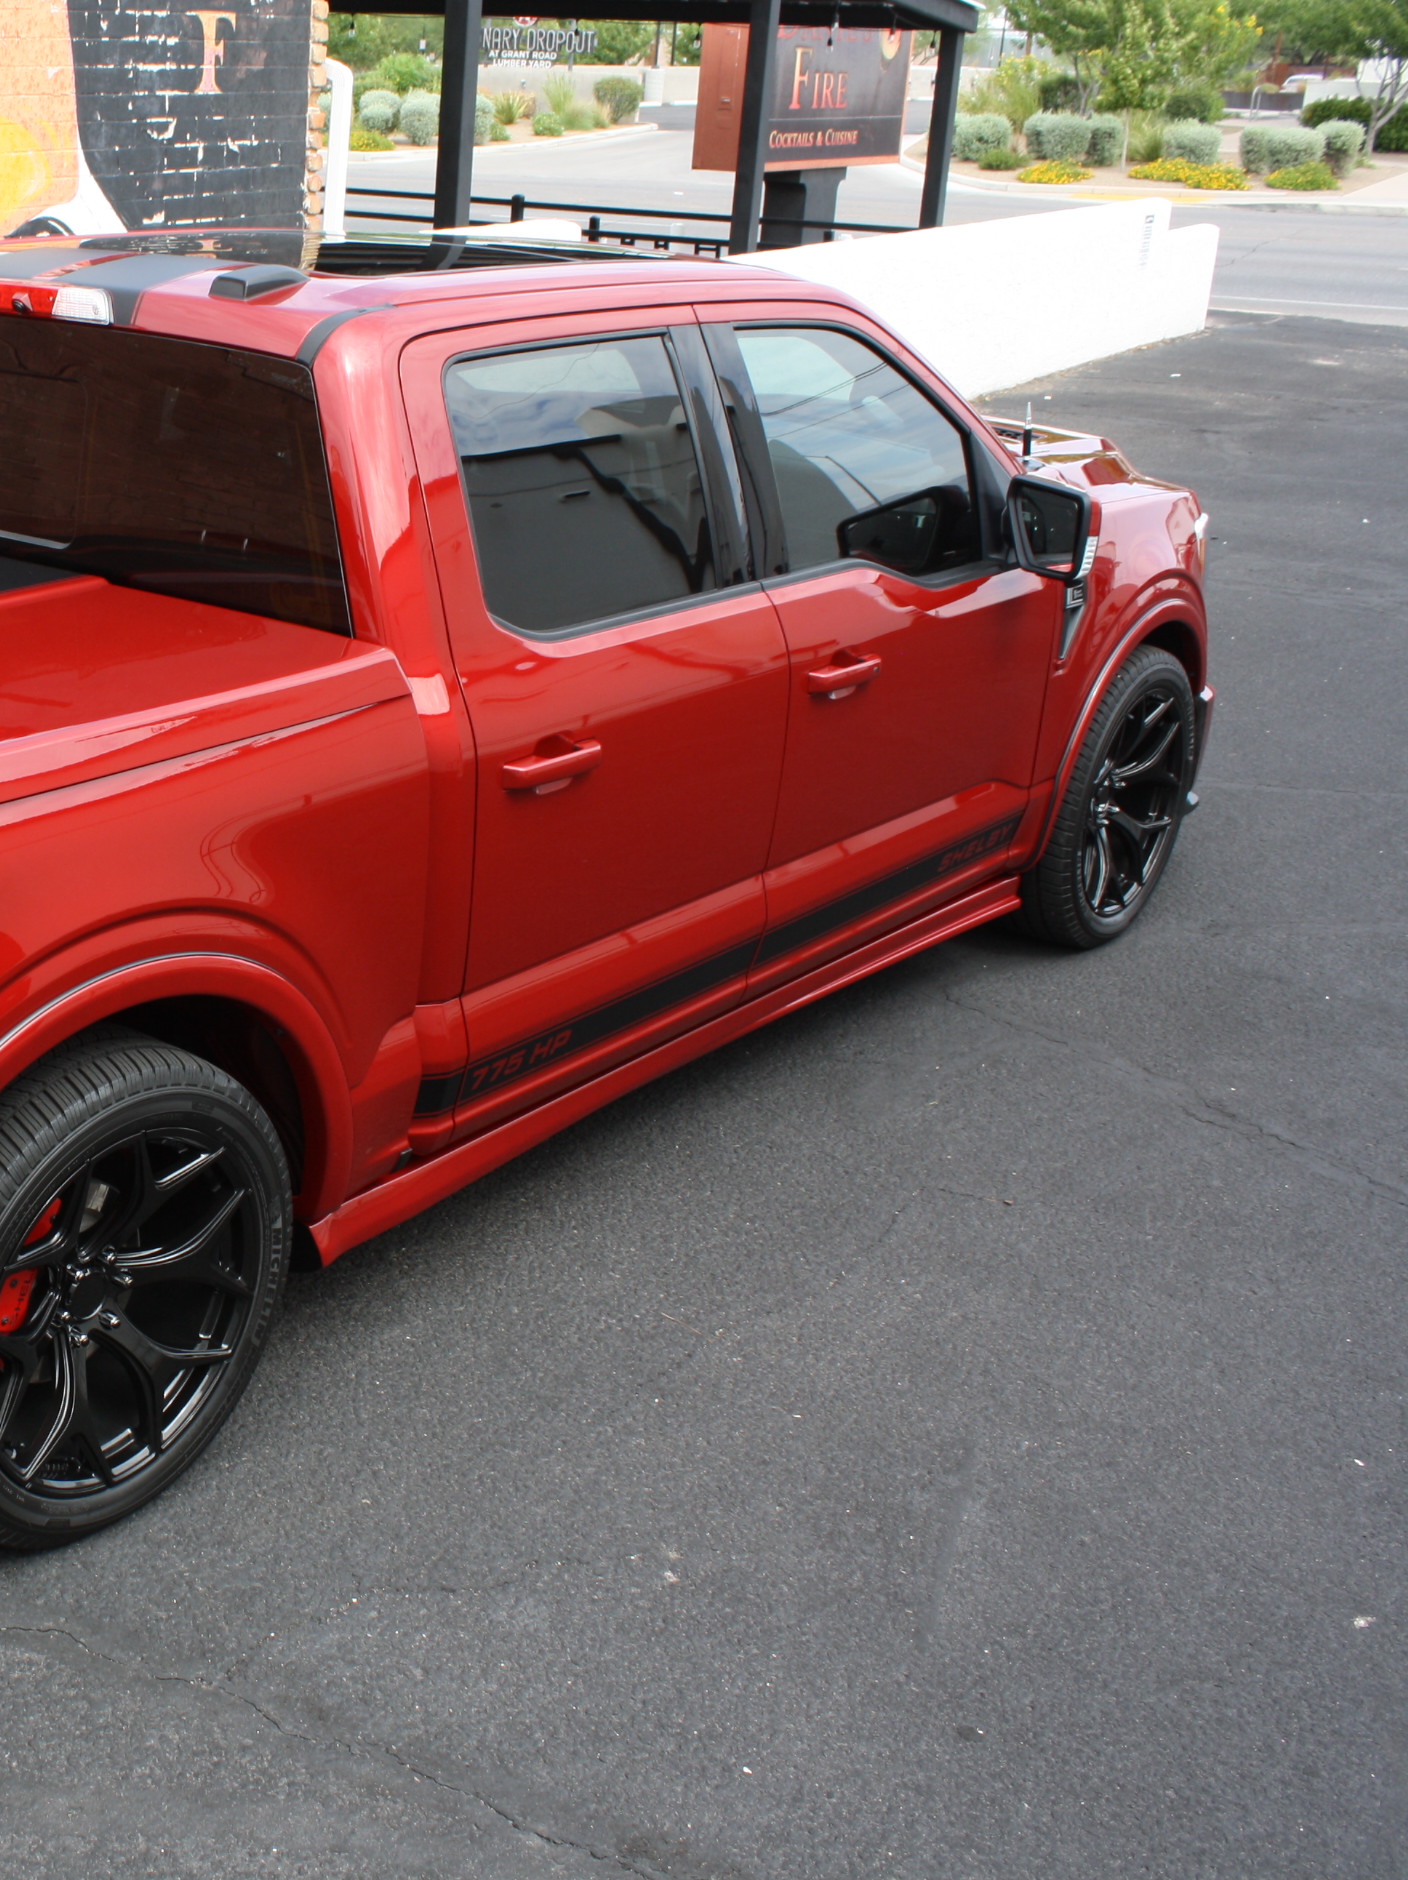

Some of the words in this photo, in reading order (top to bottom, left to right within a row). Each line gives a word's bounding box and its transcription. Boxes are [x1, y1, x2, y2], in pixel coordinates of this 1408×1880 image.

[185, 10, 237, 94] F
[482, 27, 521, 51] NARY
[527, 28, 595, 54] DROPOUT
[488, 49, 500, 58] AT
[501, 50, 531, 59] GRANT
[532, 51, 557, 60] ROAD
[492, 59, 527, 68] LUMBER
[529, 60, 552, 69] YARD
[789, 46, 849, 110] FIRE
[815, 131, 823, 146] &
[936, 823, 1013, 873] SHELBY
[471, 1049, 528, 1091] 775
[529, 1029, 573, 1066] HP
[253, 1227, 283, 1343] MICHELIN
